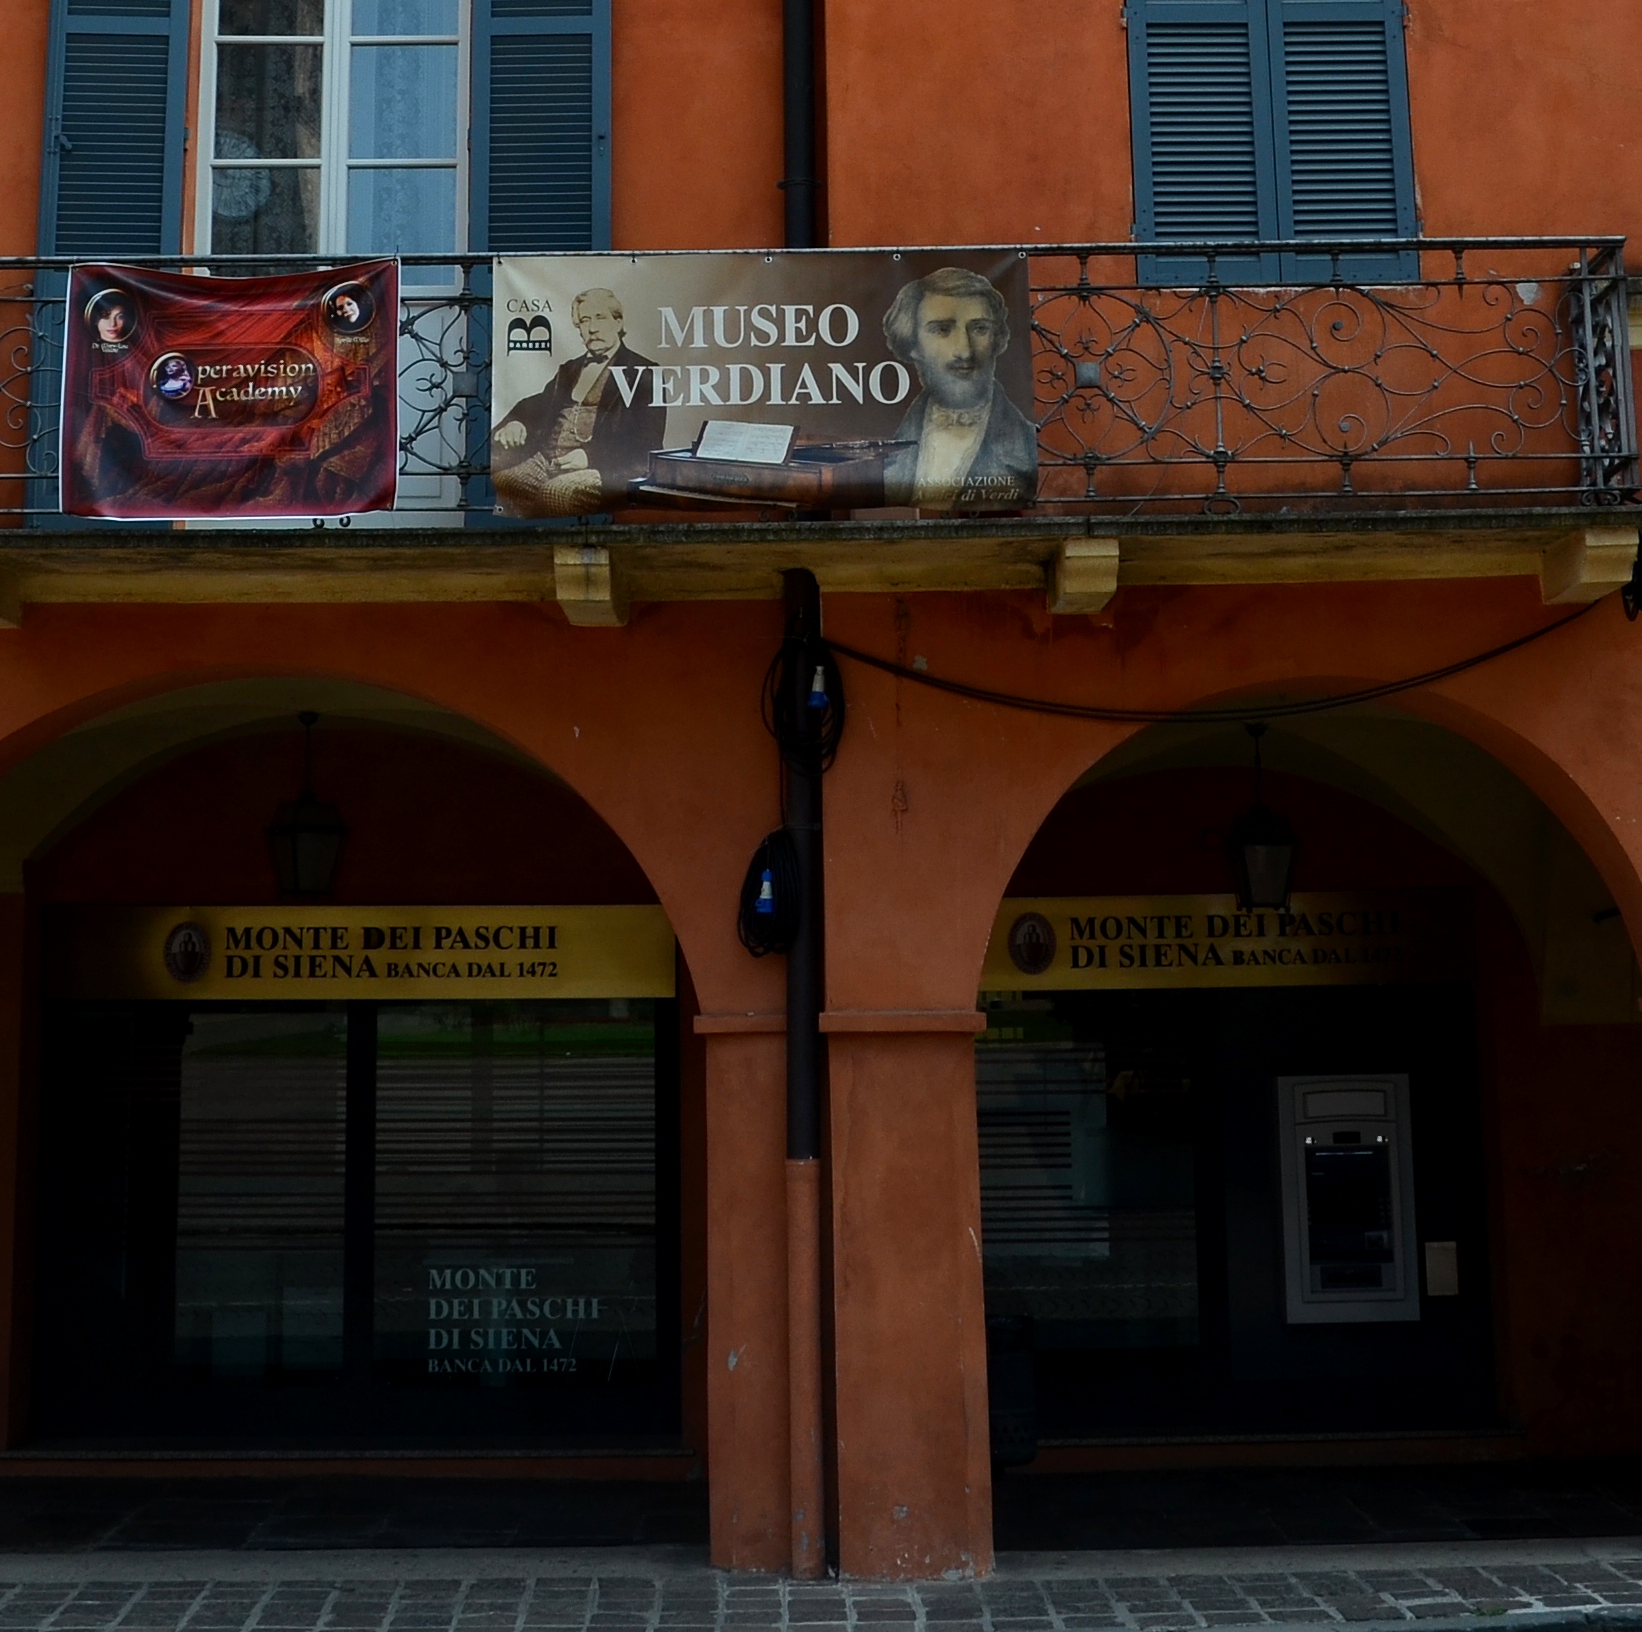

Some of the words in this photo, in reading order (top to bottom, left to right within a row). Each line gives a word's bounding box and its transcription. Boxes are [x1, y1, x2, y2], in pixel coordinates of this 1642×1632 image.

[506, 298, 553, 313] CASA
[657, 303, 860, 350] MUSEO
[509, 341, 550, 349] BAREZZI
[608, 359, 911, 408] VERDIANO
[190, 382, 303, 419] Academy
[918, 475, 1015, 487] ASSOCIAZIONE
[961, 488, 977, 501] di
[981, 488, 1020, 501] Verdi
[1069, 915, 1194, 942] MONTE
[1206, 913, 1267, 939] DEI
[1277, 909, 1401, 937] PASCHI
[224, 925, 349, 951] MONTE
[361, 925, 423, 950] DEI
[433, 924, 558, 950] PASCHI
[224, 954, 262, 979] DI
[273, 953, 378, 979] SIENA
[386, 961, 461, 978] BANCA
[465, 961, 512, 978] DAL
[516, 960, 558, 978] 1472
[1069, 944, 1108, 970] DI
[1118, 942, 1226, 968] SIENA
[1232, 948, 1308, 966] BANCA
[1312, 948, 1357, 965] DAL
[1361, 946, 1404, 964] 1472
[427, 1267, 537, 1290] MONTE
[427, 1297, 481, 1320] DEI
[490, 1297, 600, 1320] PASCHI
[427, 1327, 462, 1350] DI
[469, 1327, 563, 1350] SIENA
[427, 1358, 494, 1373] BANCA
[497, 1358, 537, 1373] DAL
[542, 1357, 578, 1373] 1472
